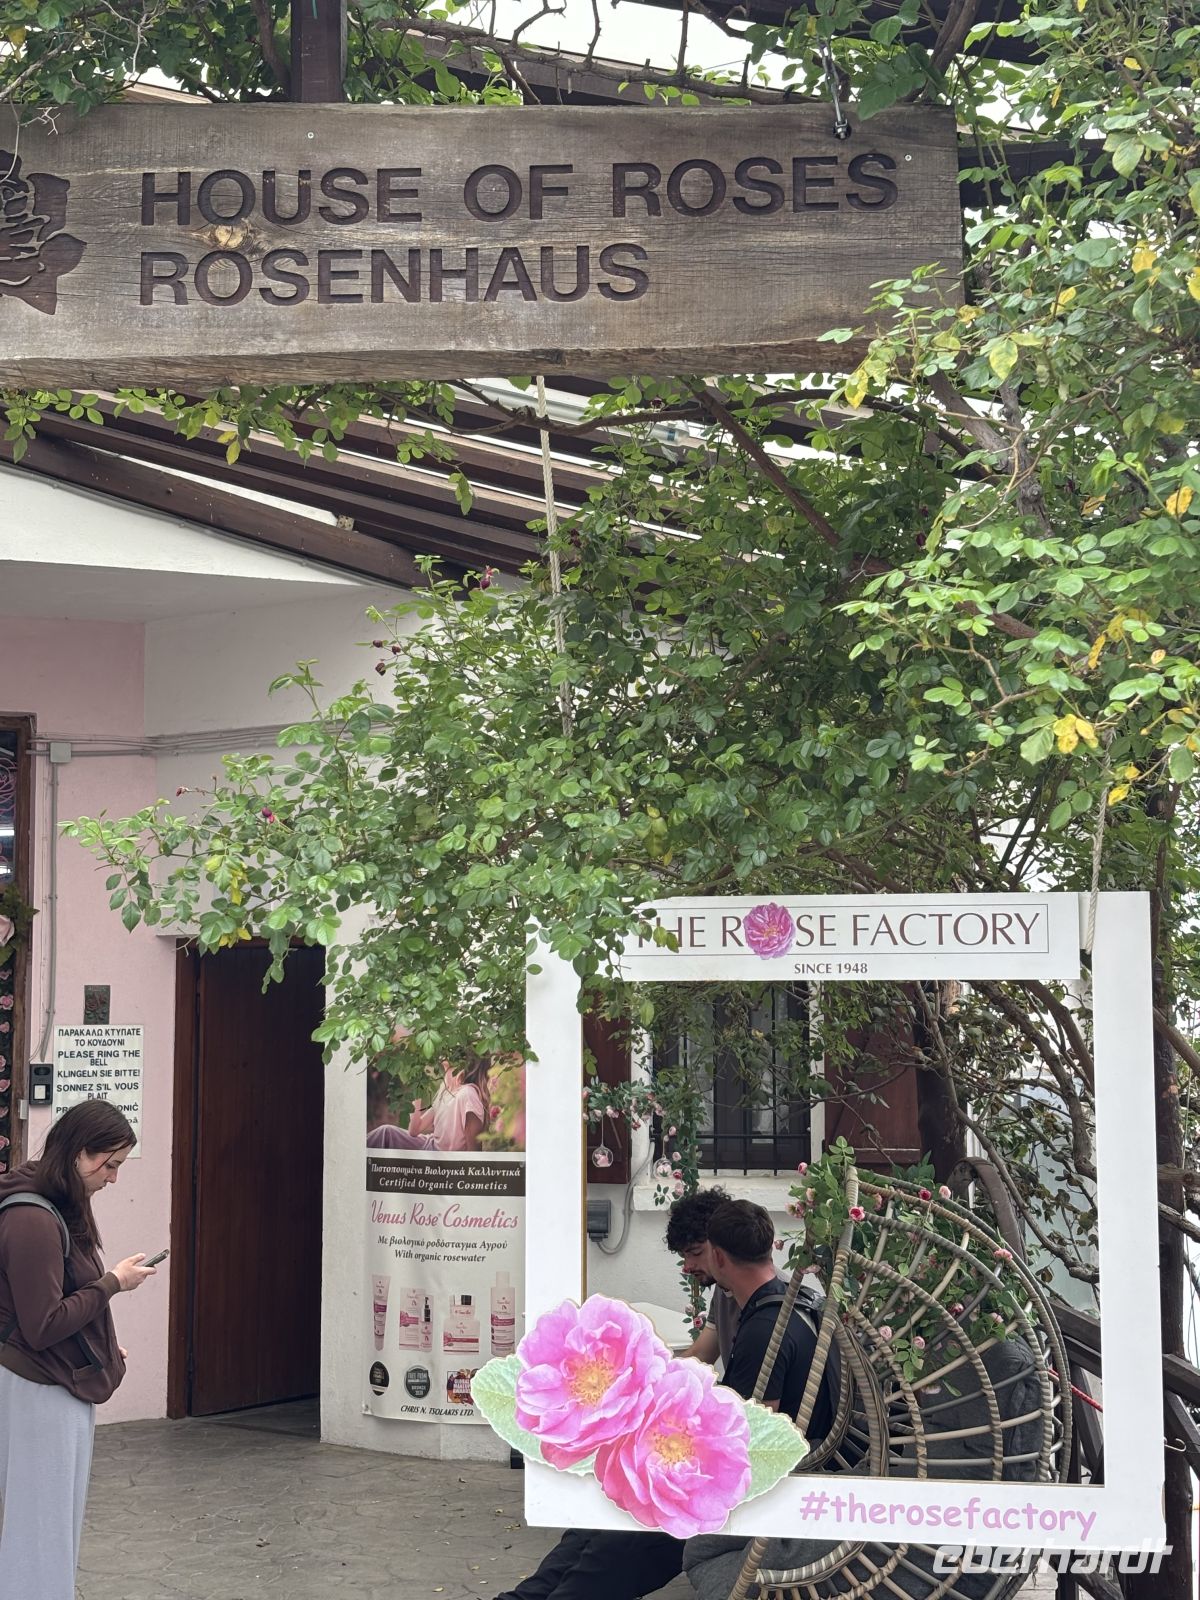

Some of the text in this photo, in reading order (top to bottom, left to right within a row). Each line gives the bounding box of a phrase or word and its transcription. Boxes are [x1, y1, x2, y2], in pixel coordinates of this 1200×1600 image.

[140, 153, 898, 225] HOUSE OF ROSES
[139, 243, 650, 306] ROSENHAUS
[722, 913, 836, 948] RSE
[852, 912, 1040, 947] FACTORY
[794, 962, 868, 974] SINCE 1948
[58, 1028, 141, 1037] ΠΑΡΑΚΑΛΩ ΚΤΥΠΑΤΕ
[97, 1050, 120, 1058] RING
[90, 1058, 108, 1066] BELL
[57, 1069, 140, 1078] KLINGELN SIE BITTE!
[56, 1082, 139, 1092] SONNEZ S'IL VOUS
[424, 1166, 466, 1178] Βιολογικά
[467, 1167, 521, 1177] Καλλυντικά
[379, 1177, 508, 1191] Certified Organic Cosmetics
[371, 1200, 407, 1224] Venus
[443, 1203, 519, 1229] Cosmetics
[377, 1235, 389, 1245] Με
[395, 1249, 486, 1263] With organic rosewater
[400, 1405, 419, 1414] CHRIS
[429, 1408, 459, 1416] TSOLAKIS
[800, 1491, 1097, 1541] #therosefactory
